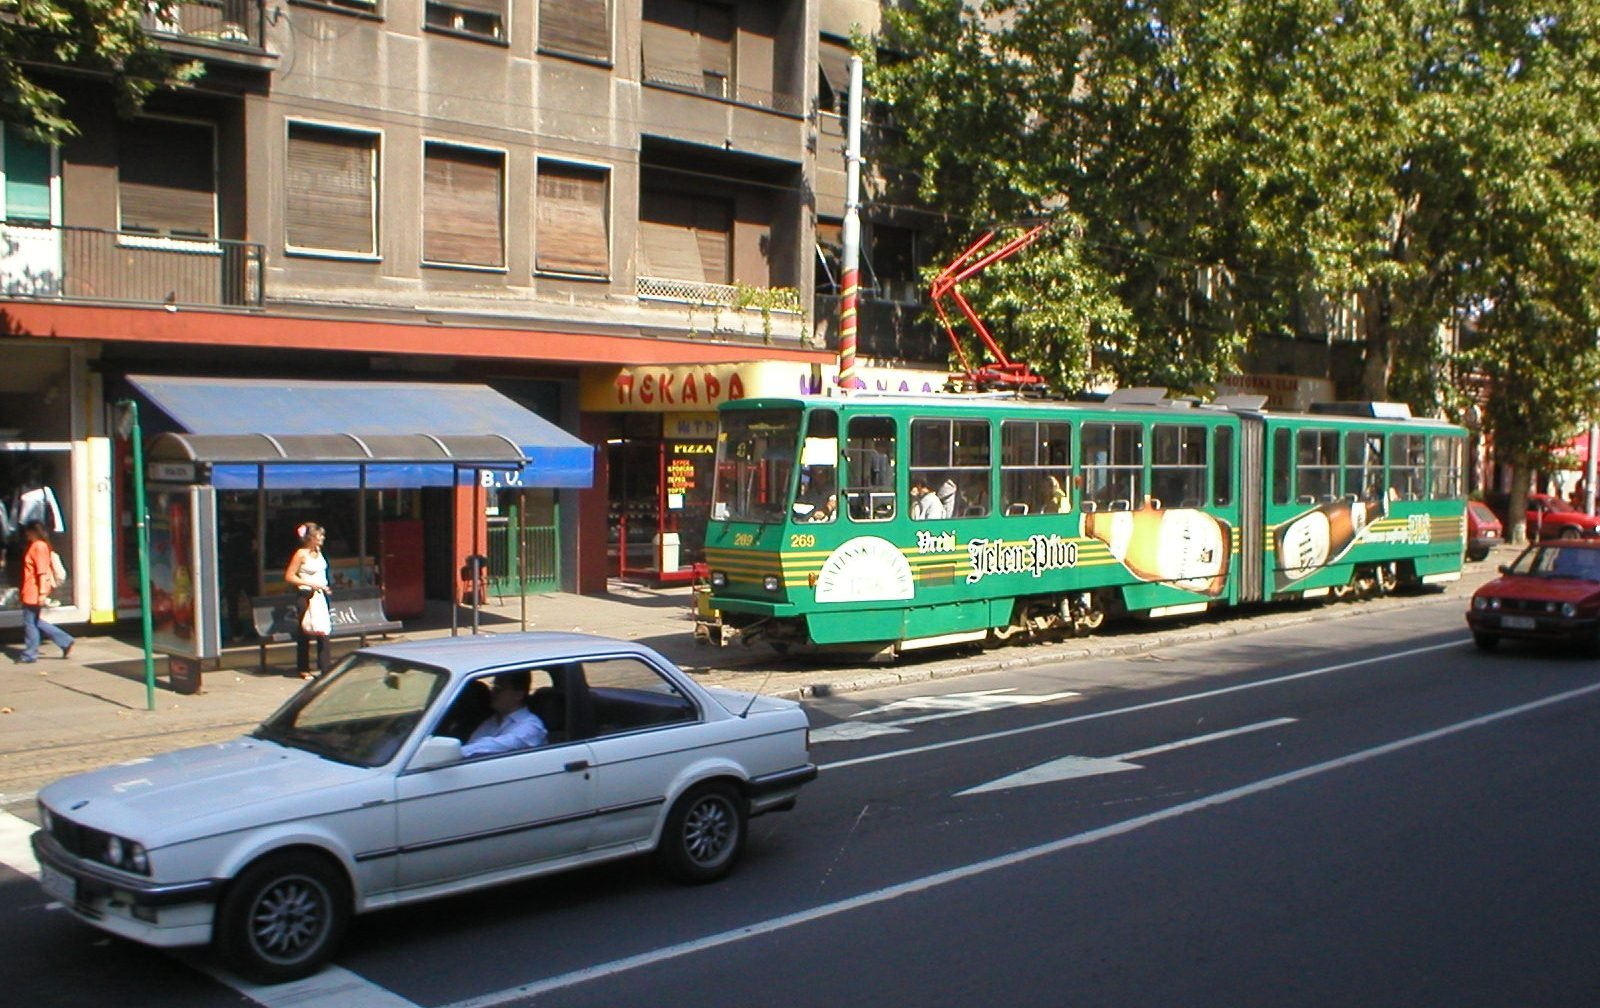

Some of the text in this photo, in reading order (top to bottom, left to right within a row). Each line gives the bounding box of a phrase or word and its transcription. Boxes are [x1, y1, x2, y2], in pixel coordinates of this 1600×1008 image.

[674, 444, 714, 454] PIZZA
[790, 534, 816, 548] 269
[966, 538, 1025, 585] Jelen
[1023, 533, 1079, 578] Pivo
